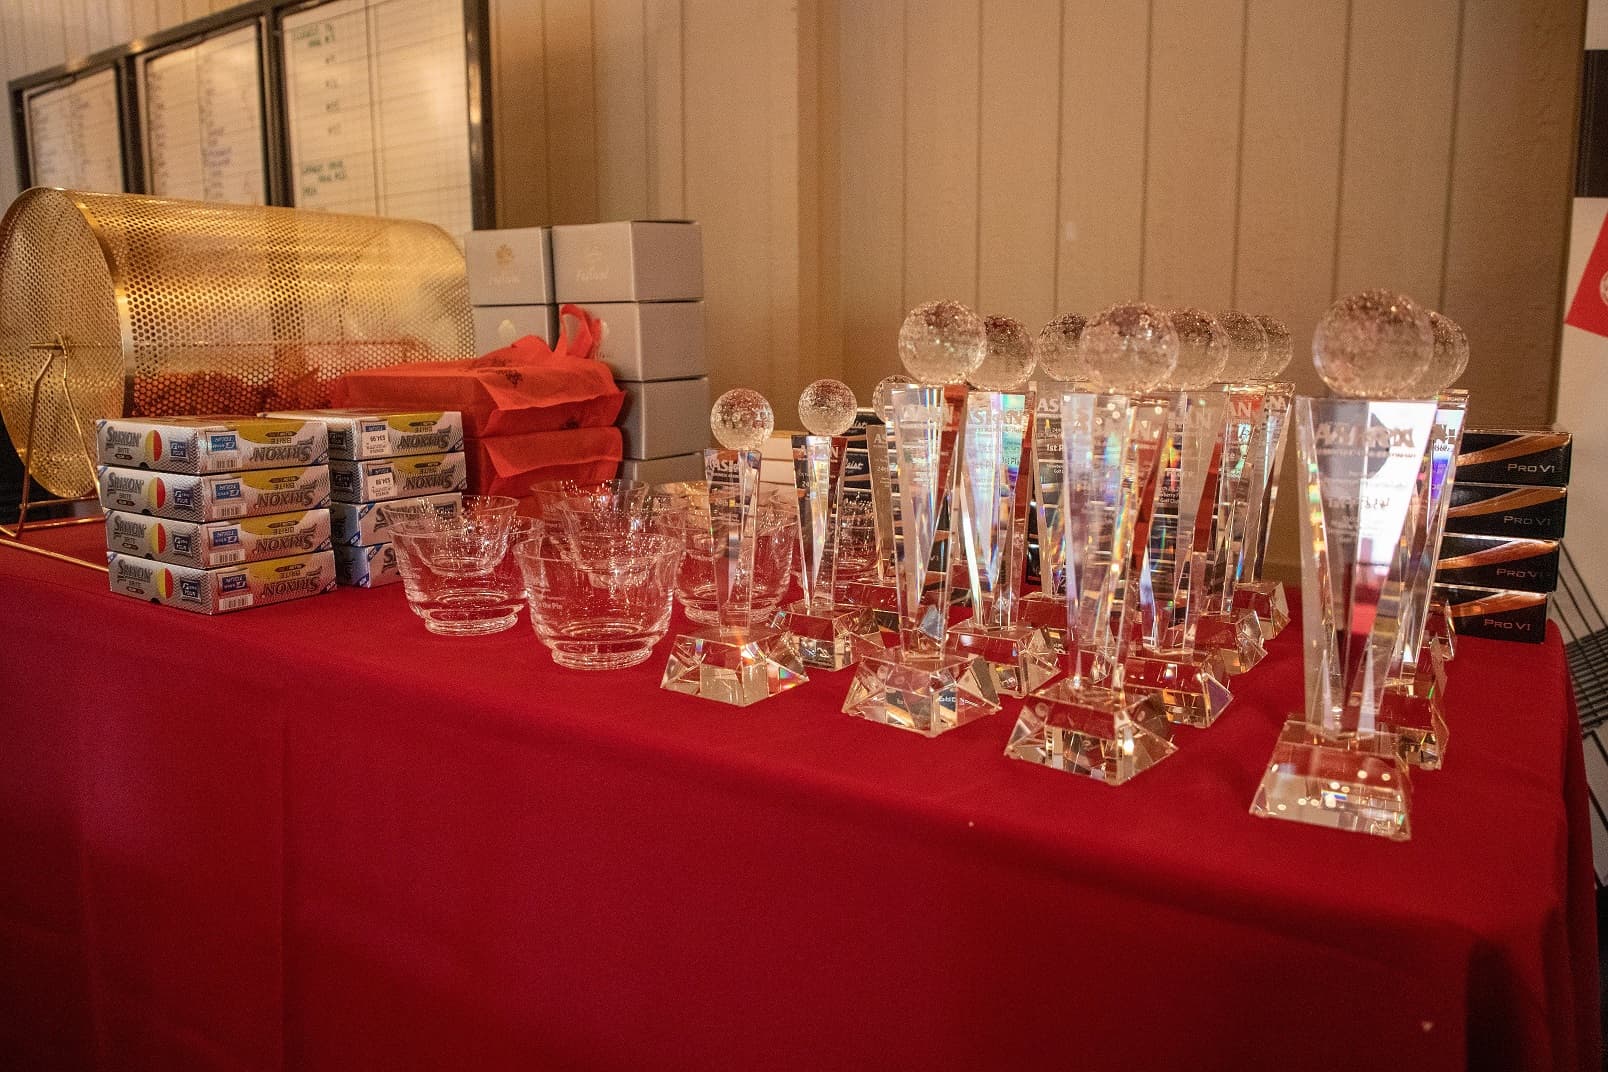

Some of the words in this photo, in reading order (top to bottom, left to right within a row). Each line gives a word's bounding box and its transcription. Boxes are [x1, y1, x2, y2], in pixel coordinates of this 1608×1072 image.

[248, 444, 314, 462] SRIXON
[1507, 463, 1537, 473] PRO
[1539, 464, 1556, 473] V1
[256, 490, 315, 507] SRIXON
[253, 535, 314, 553] SRIXON
[262, 577, 322, 596] SRIXON
